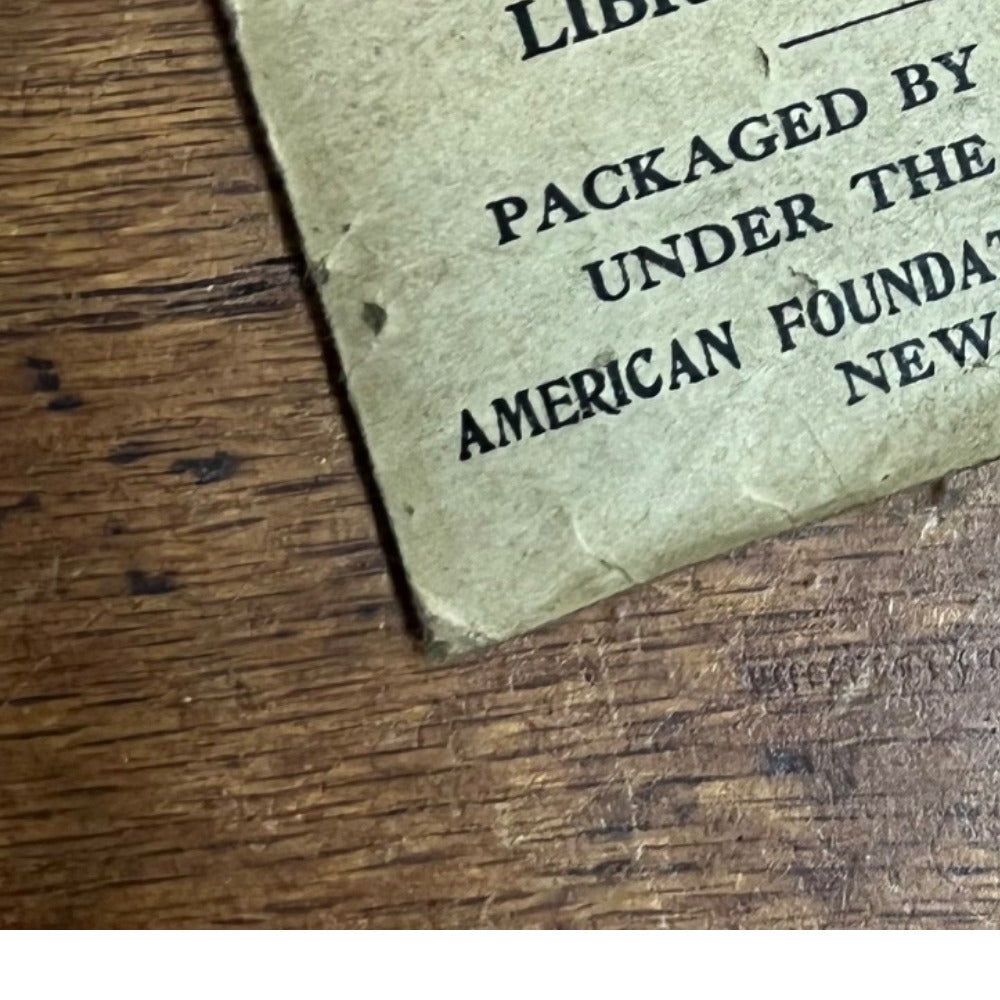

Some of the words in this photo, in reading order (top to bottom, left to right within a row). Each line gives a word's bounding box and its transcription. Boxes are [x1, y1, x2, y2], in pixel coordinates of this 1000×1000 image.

[485, 86, 868, 246] PACKAGED
[891, 43, 980, 113] BY
[581, 194, 834, 304] UNDER
[851, 133, 998, 216] THE
[457, 322, 744, 461] AMERICAN
[834, 313, 1000, 408] NEW
